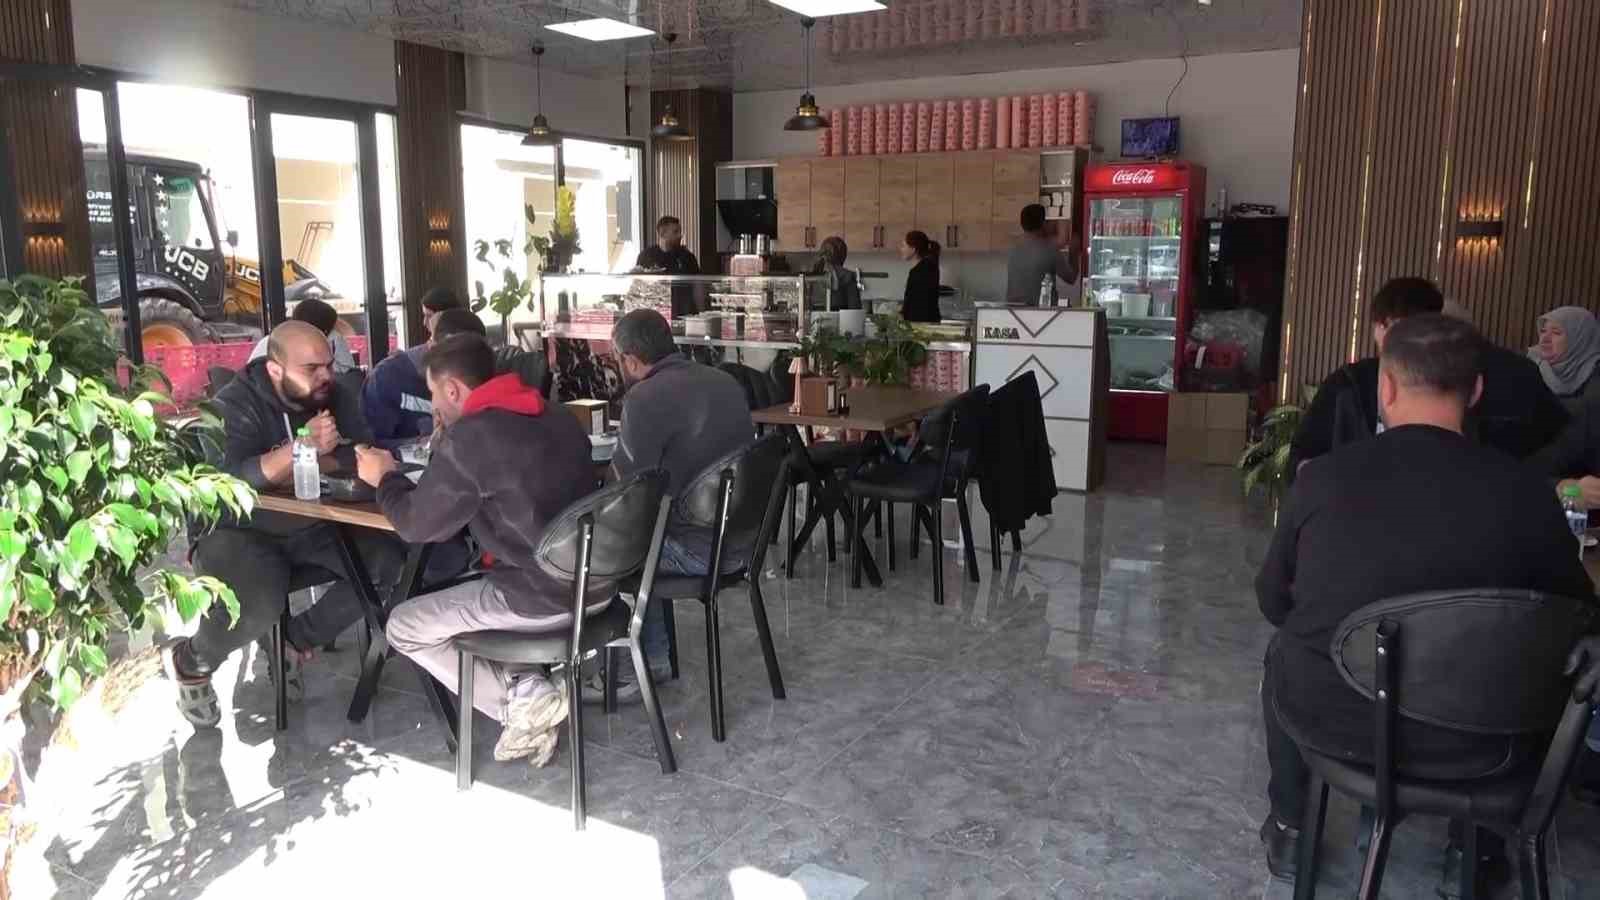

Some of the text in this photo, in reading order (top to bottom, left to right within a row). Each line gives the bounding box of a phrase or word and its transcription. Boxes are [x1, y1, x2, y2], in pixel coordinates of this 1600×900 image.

[164, 245, 209, 281] JCB
[235, 264, 260, 281] JC
[983, 327, 1020, 339] KASA
